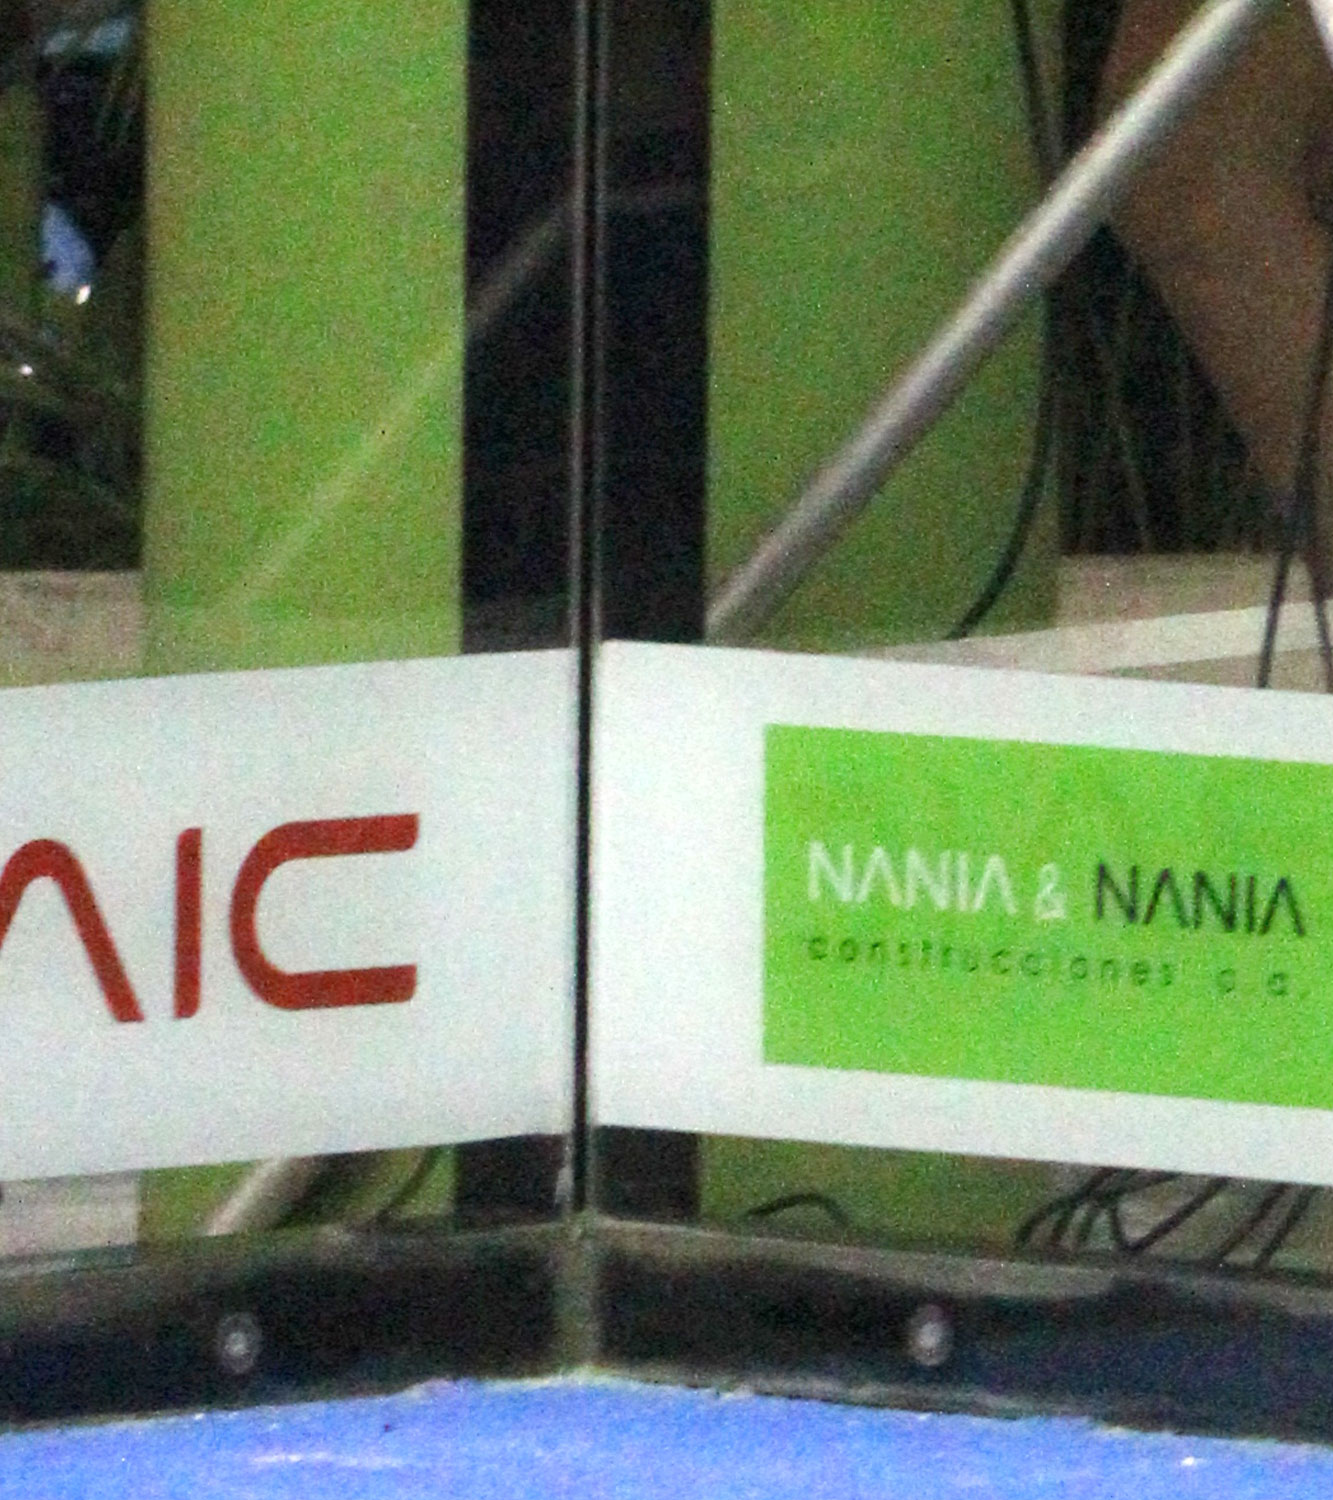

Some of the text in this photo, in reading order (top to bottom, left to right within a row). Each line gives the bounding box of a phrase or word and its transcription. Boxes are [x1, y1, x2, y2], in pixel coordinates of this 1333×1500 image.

[806, 841, 1307, 938] NANIA & NANIA
